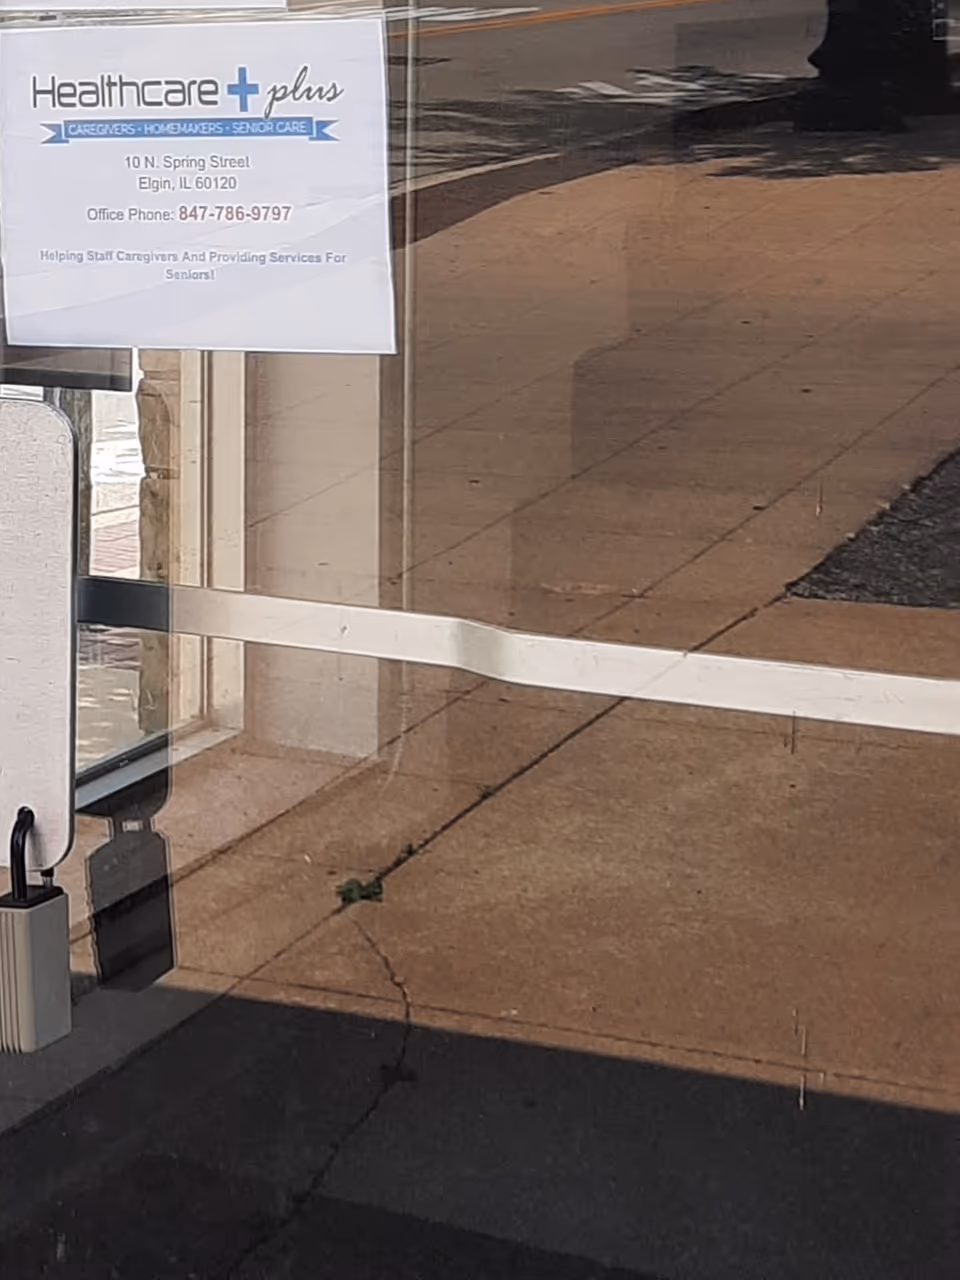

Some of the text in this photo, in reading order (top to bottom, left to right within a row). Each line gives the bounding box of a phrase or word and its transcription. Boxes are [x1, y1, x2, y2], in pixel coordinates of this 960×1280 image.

[32, 66, 345, 119] Healthcare plus
[69, 121, 307, 136] CAREGIVERS HOMEMAKERS SENIOR CARE
[125, 156, 250, 172] 10 N. Spring Street
[139, 176, 237, 193] Elgin, IL 60120
[87, 205, 292, 222] Office Phone: 847-786-9797
[40, 249, 347, 265] Helping Staff Caregivers And Providing Services For
[166, 269, 214, 281] Seniors!
